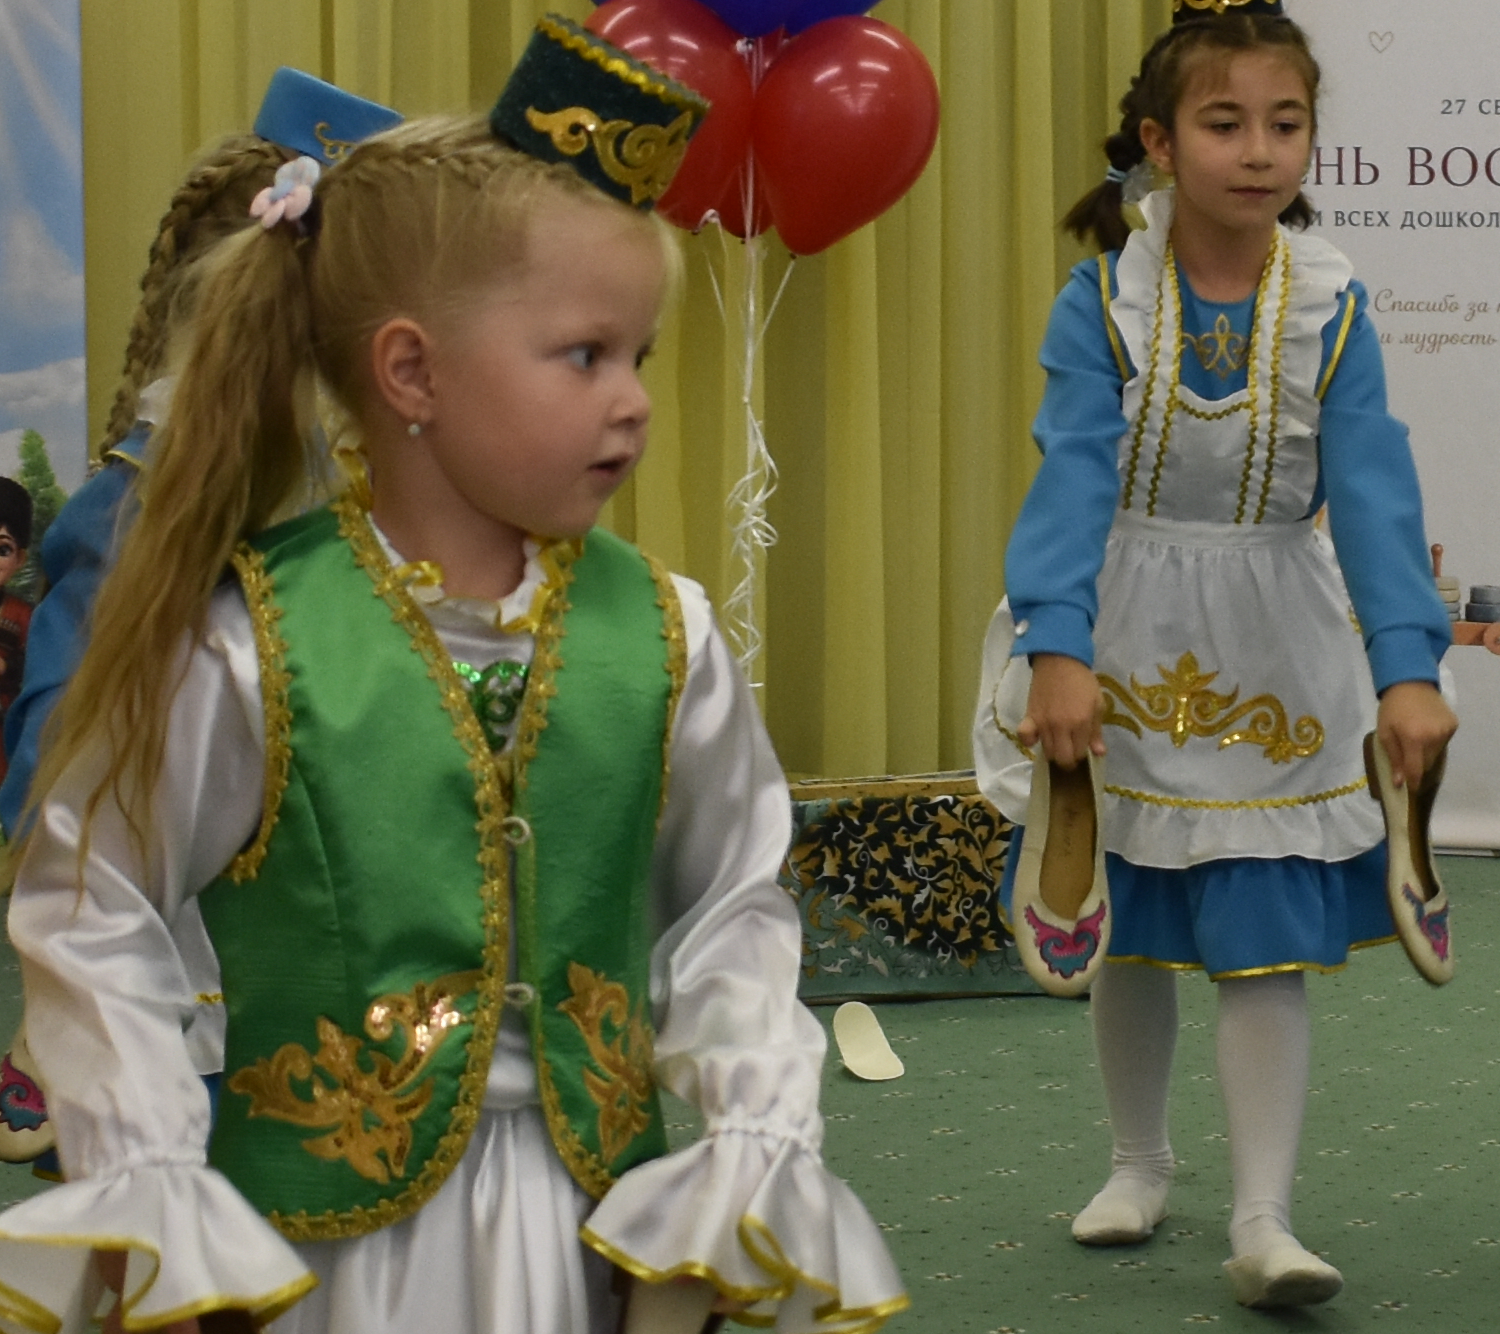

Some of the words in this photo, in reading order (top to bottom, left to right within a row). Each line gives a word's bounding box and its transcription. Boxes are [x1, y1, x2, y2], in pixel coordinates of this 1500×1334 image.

[1440, 98, 1467, 116] 27
[1301, 146, 1380, 186] НЬ
[1333, 210, 1391, 228] ВСЕХ
[1373, 288, 1461, 313] Спасибо
[1464, 300, 1490, 322] за
[1399, 332, 1498, 354] мудрость
